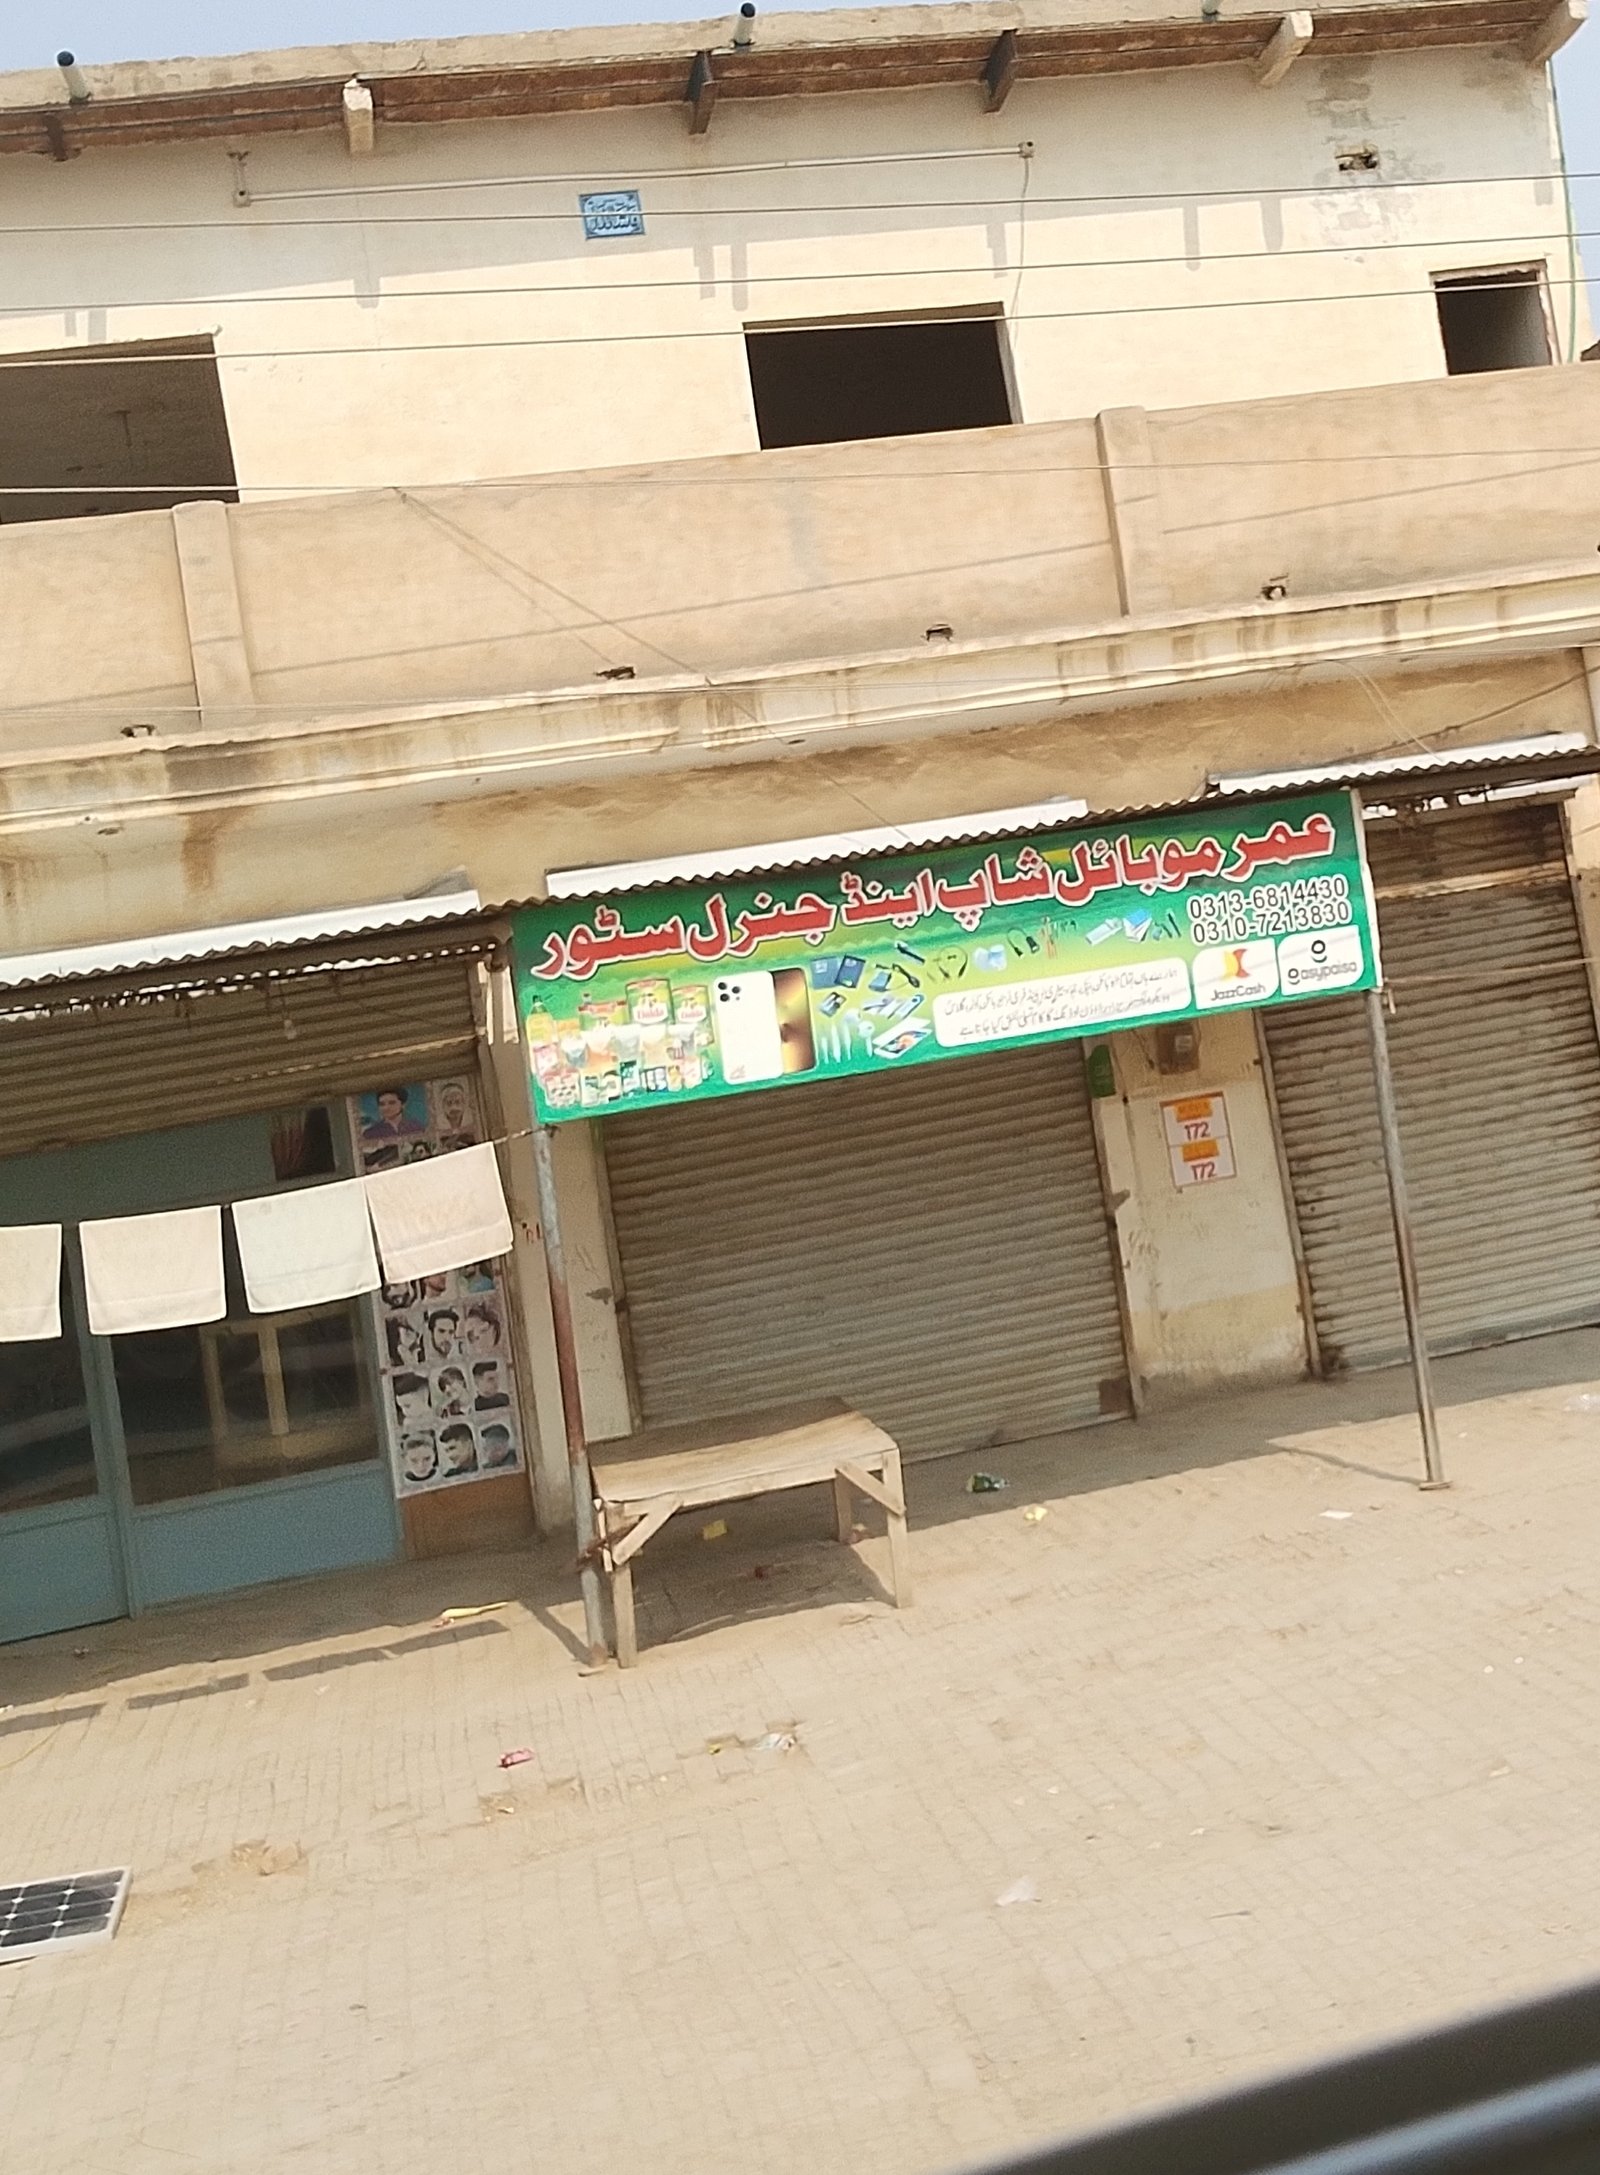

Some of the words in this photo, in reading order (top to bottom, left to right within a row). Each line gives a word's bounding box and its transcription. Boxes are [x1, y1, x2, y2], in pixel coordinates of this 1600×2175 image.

[1056, 836, 1226, 905] موبائل
[1222, 814, 1335, 881] عمر
[840, 869, 936, 928] اینڈ
[936, 847, 1053, 931] شاپ
[1189, 876, 1346, 919] 0313-6814430
[532, 905, 686, 980] سٹور
[687, 893, 836, 961] جنرل
[1193, 901, 1350, 943] 0310-7213830
[1211, 984, 1266, 1001] JazzCash
[1184, 1121, 1211, 1141] 172
[1190, 1162, 1217, 1181] 172
